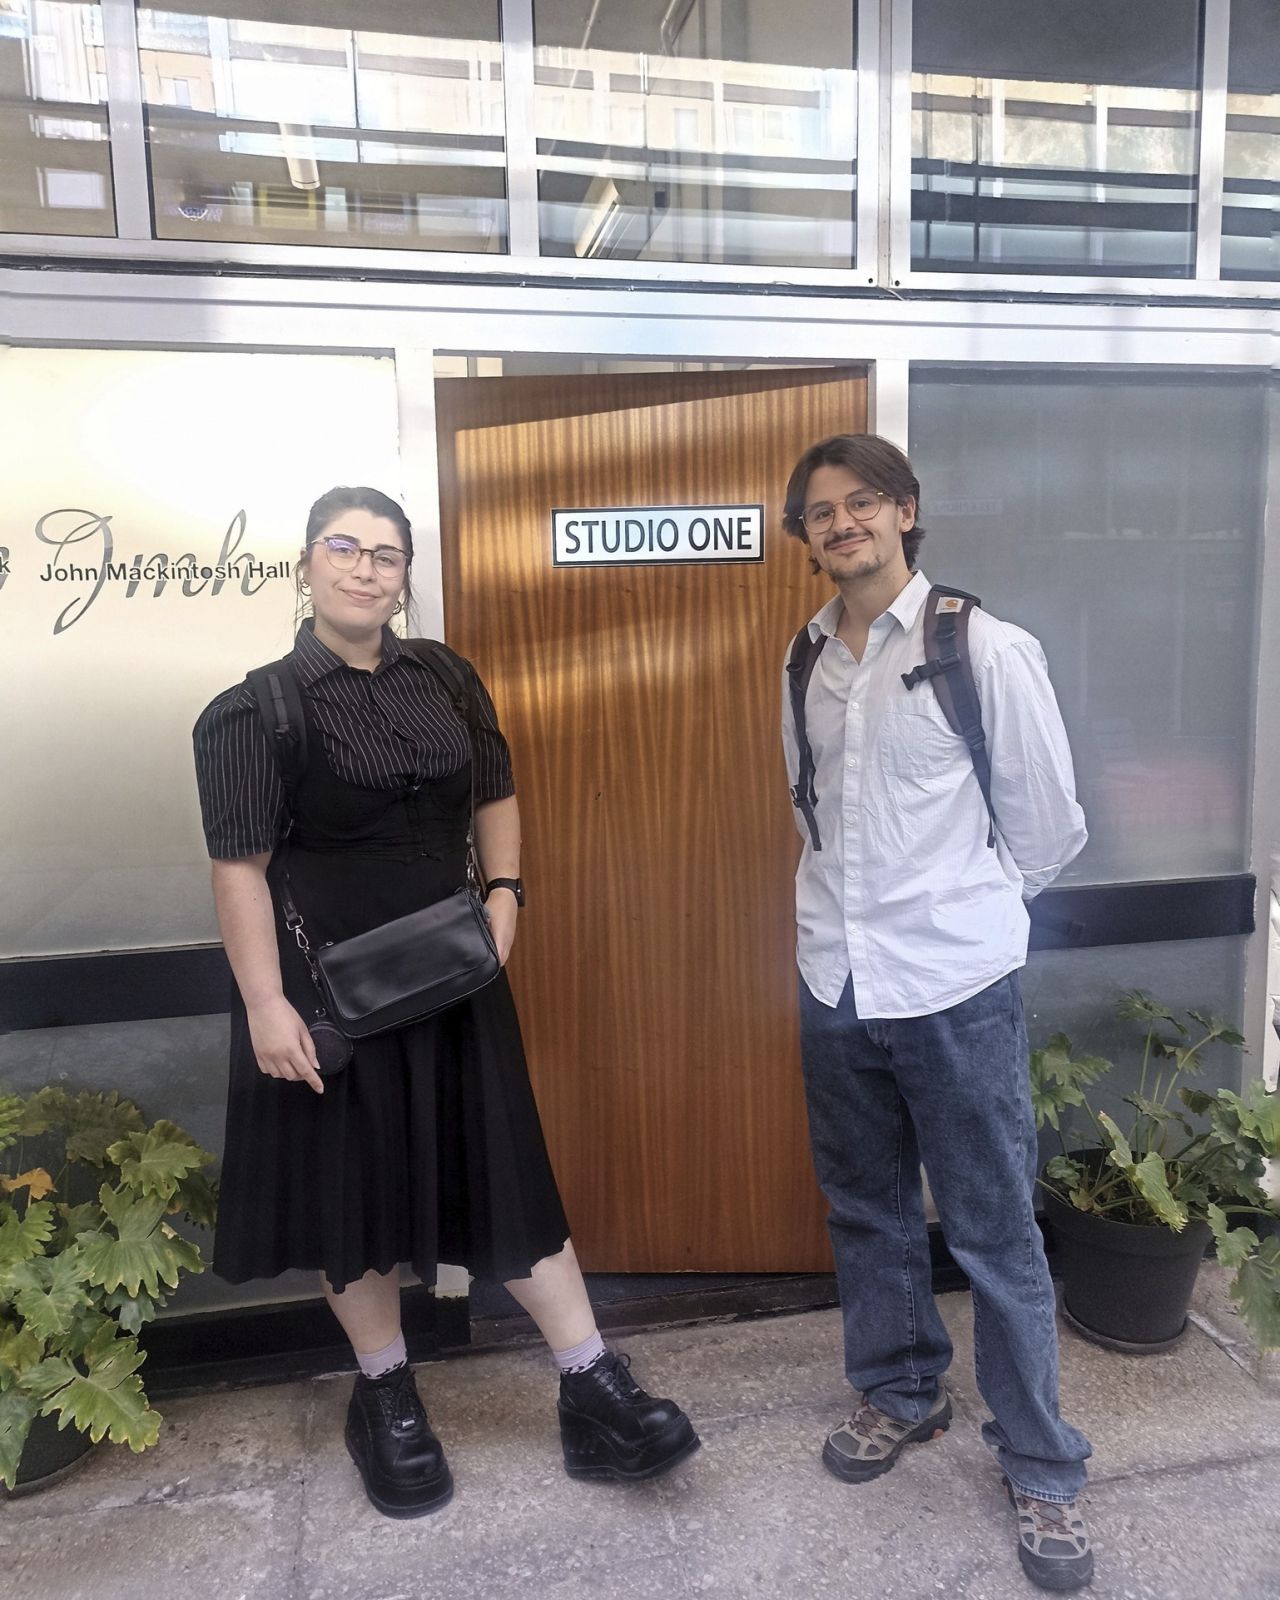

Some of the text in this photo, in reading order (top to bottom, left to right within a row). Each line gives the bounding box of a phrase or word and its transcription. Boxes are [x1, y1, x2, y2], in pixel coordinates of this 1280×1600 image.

[565, 517, 752, 554] STUDIO ONE
[40, 561, 290, 582] John Mackintosh Hall
